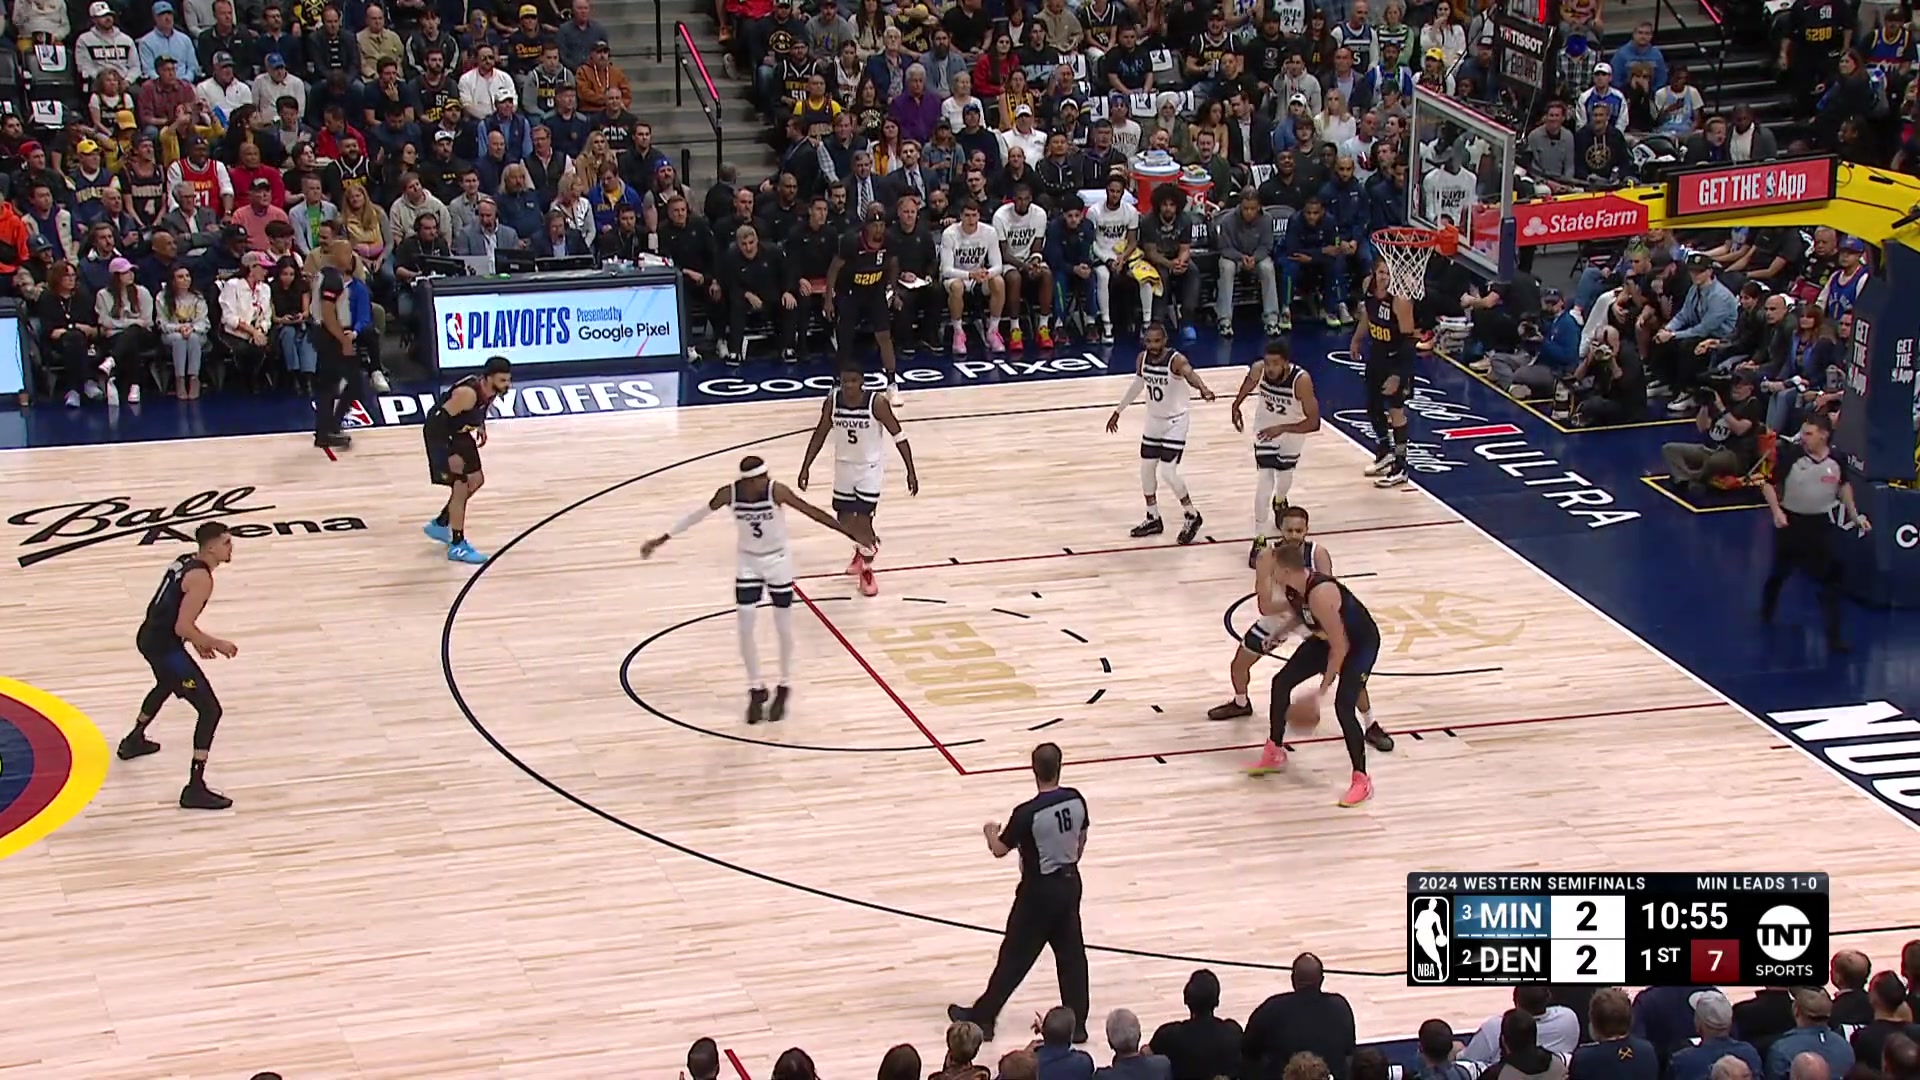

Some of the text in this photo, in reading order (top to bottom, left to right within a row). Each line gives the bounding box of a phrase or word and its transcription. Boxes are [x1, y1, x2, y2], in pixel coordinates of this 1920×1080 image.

[1511, 29, 1543, 54] TISSOT
[1700, 170, 1806, 206] GET THE App
[577, 306, 622, 322] Presented by
[1378, 304, 1391, 320] 50
[468, 306, 570, 349] PLAYOFFS
[578, 321, 670, 342] Google Pixel
[1369, 321, 1391, 341] 280
[1896, 338, 1914, 353] GET
[953, 352, 1110, 379] Pixel
[1896, 352, 1912, 367] THE
[1147, 386, 1163, 402] 10
[835, 420, 870, 429] WOLVES
[848, 430, 858, 445] 5
[1474, 441, 1641, 529] ULTRA
[7, 486, 256, 546] Ball
[736, 512, 774, 521] WOLVES
[138, 516, 368, 546] Aena
[750, 523, 763, 538] 3
[867, 621, 1037, 706] 5280
[1055, 807, 1073, 834] 16
